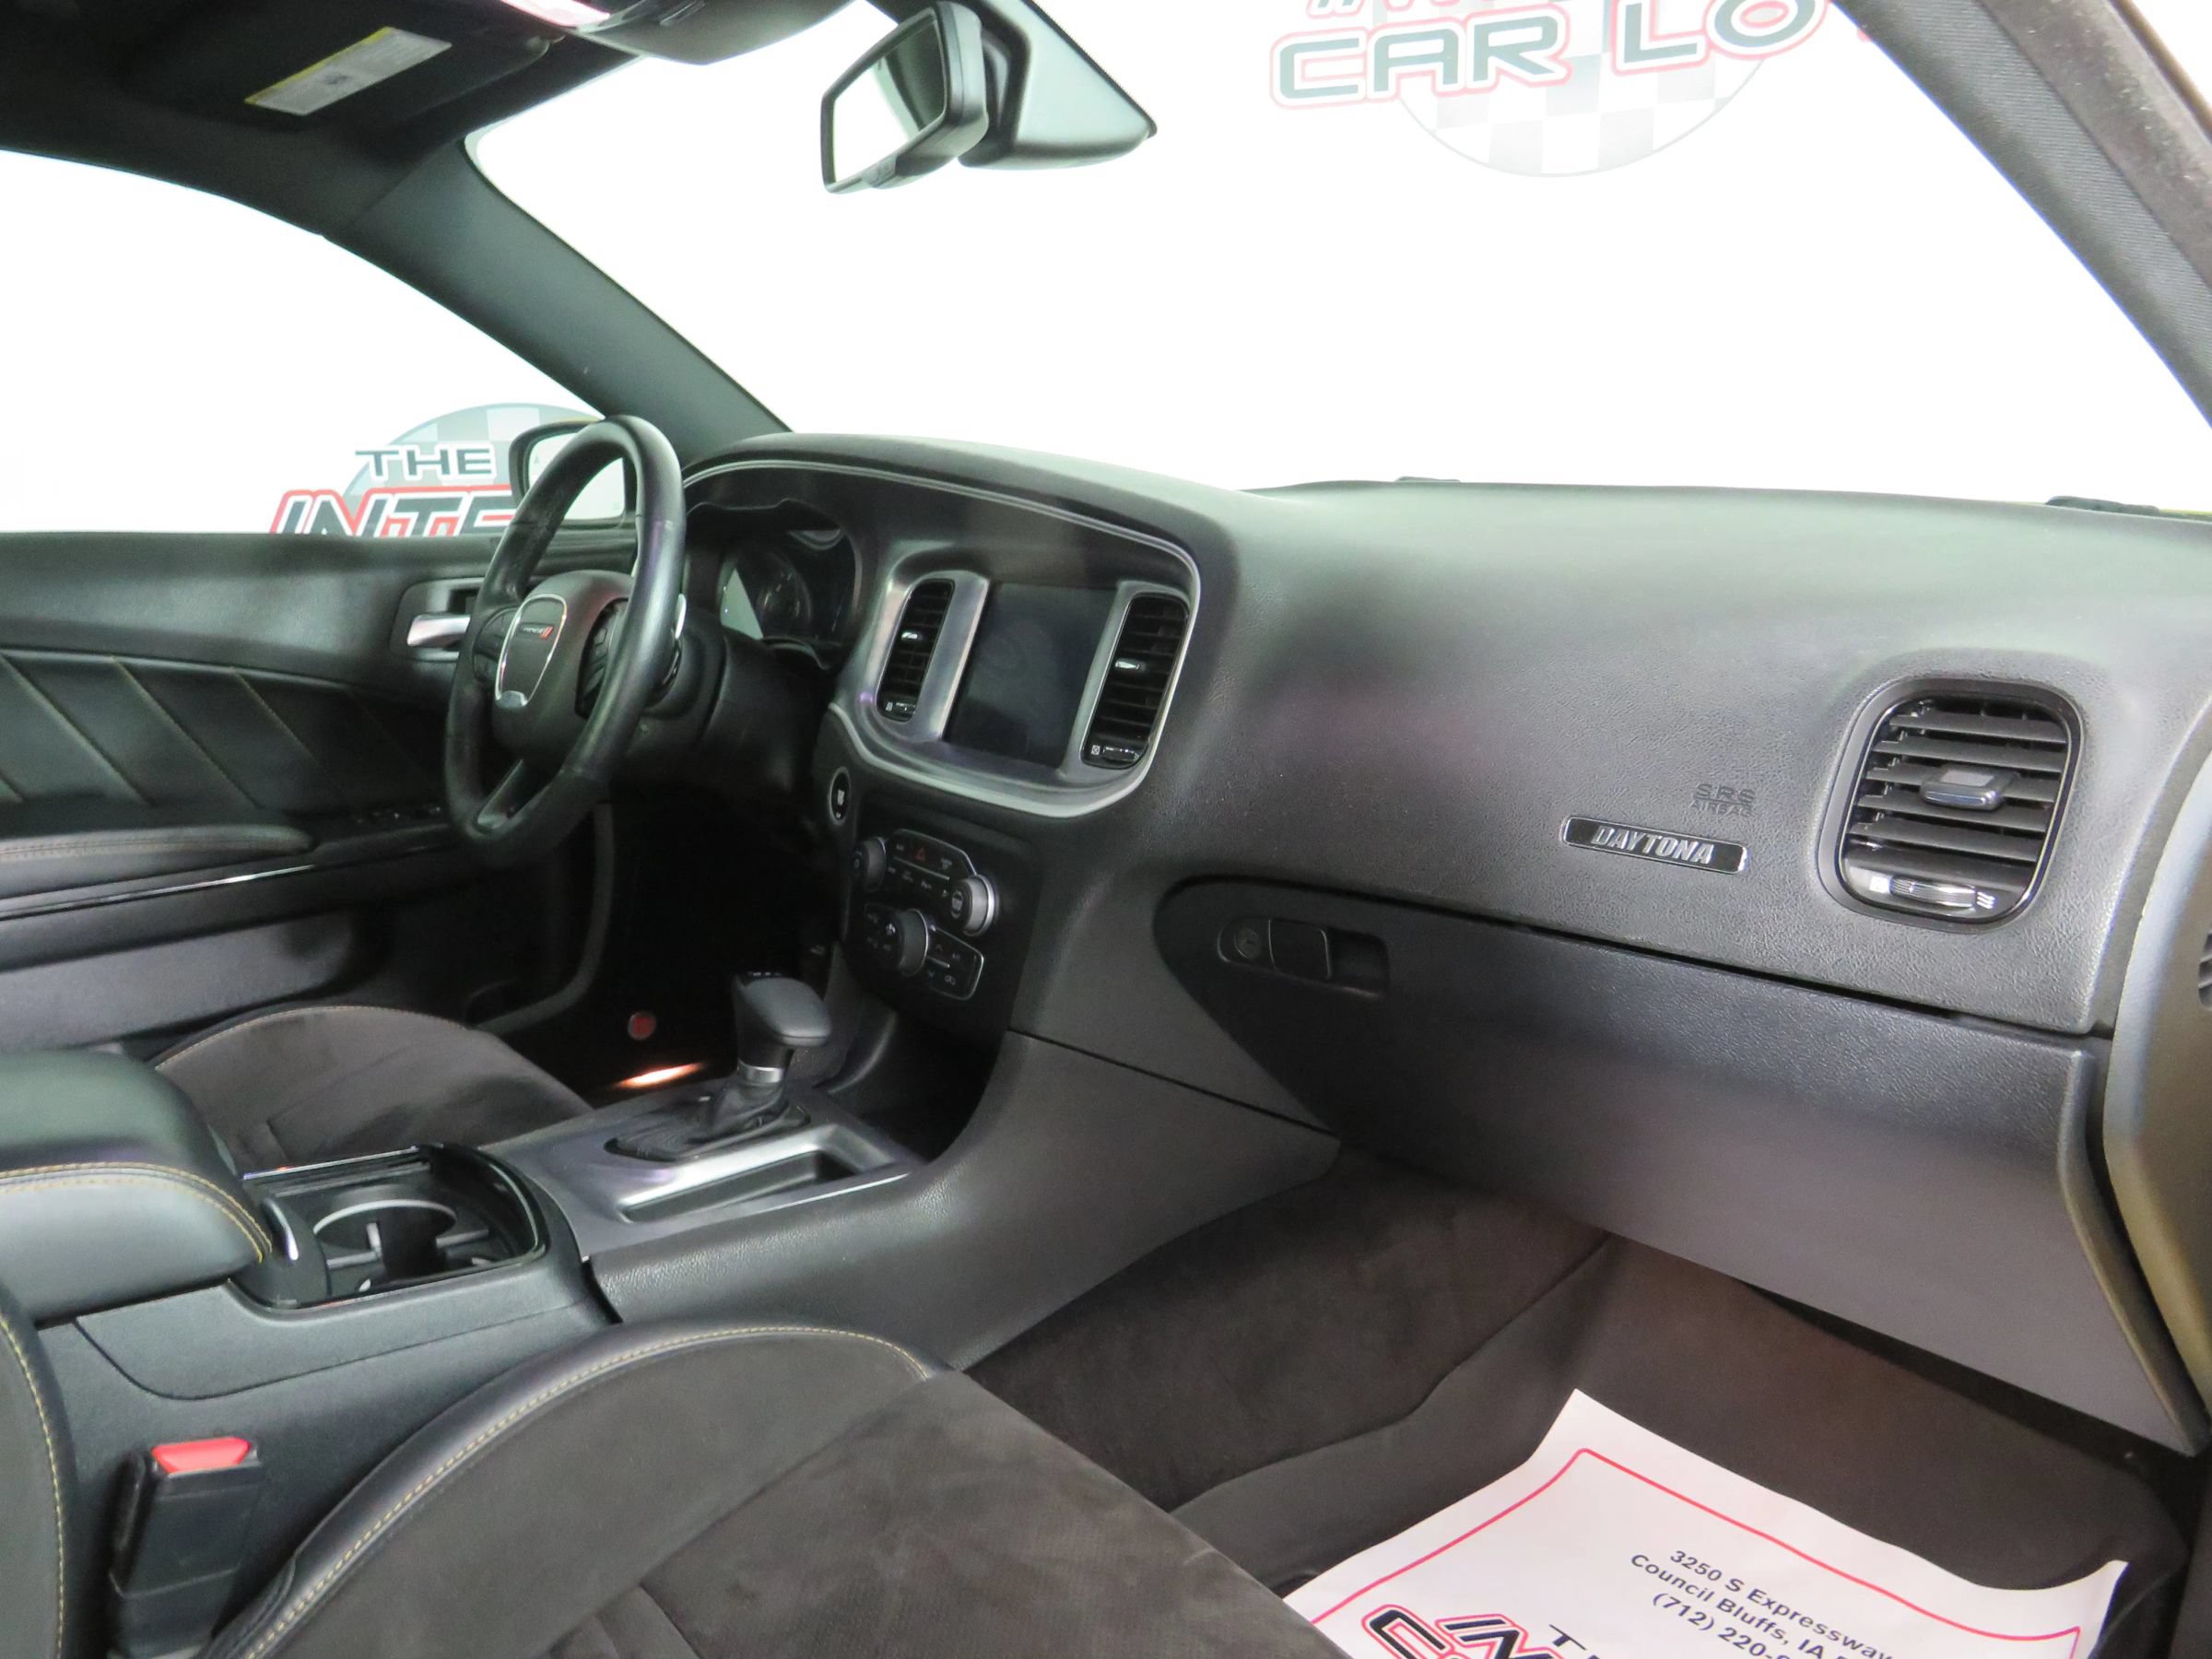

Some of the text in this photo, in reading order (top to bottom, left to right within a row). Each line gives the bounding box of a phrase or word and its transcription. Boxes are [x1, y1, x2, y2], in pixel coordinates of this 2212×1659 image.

[1276, 11, 1563, 101] CAR
[355, 448, 492, 477] THE
[1590, 824, 1714, 865] DAYTONA
[1669, 1550, 1723, 1582] 3250
[1724, 1577, 1745, 1594] S
[1630, 1553, 1824, 1659] Council Bluffs, IA
[1652, 1593, 1791, 1659] (712) 220-
